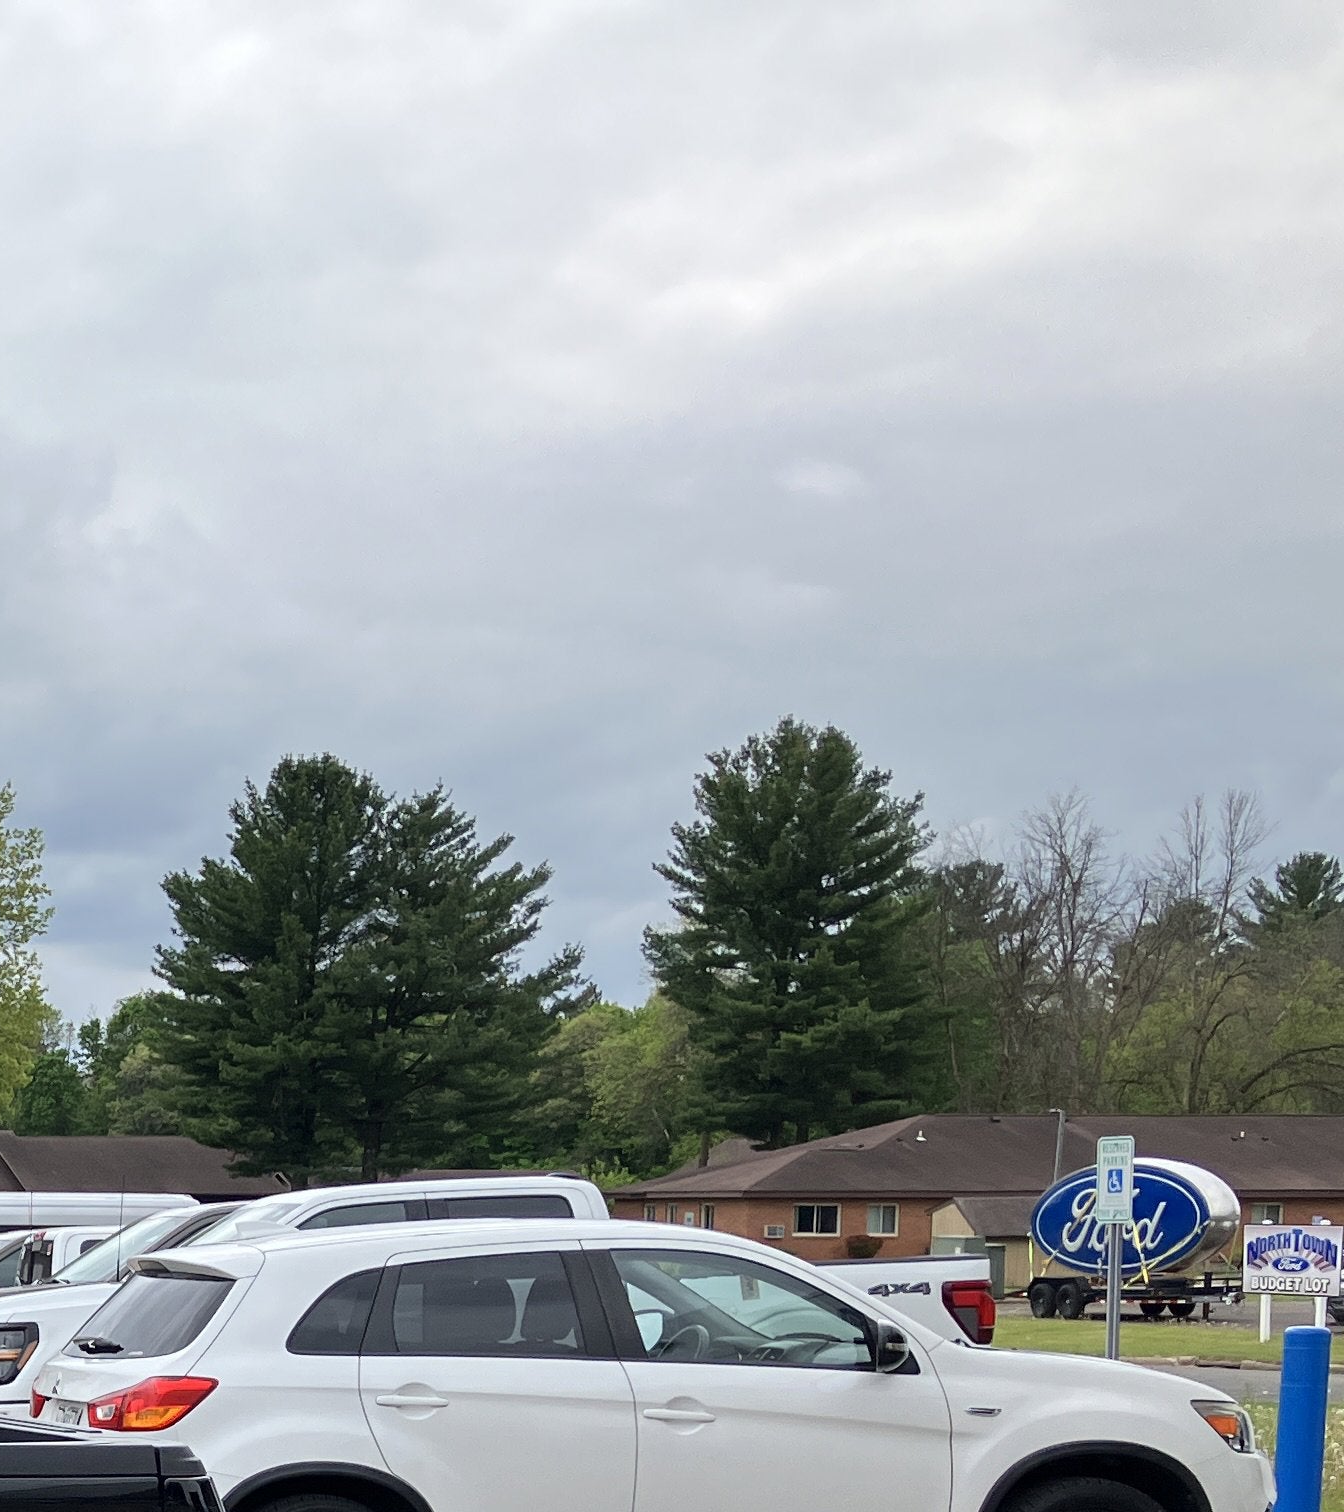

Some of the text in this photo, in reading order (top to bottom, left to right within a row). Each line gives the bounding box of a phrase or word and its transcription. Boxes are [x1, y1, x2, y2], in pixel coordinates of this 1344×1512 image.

[1102, 1143, 1130, 1153] RESERVED
[1102, 1156, 1129, 1167] PARKING
[1278, 1257, 1304, 1271] Ford
[1251, 1275, 1330, 1293] BUDGET LOT
